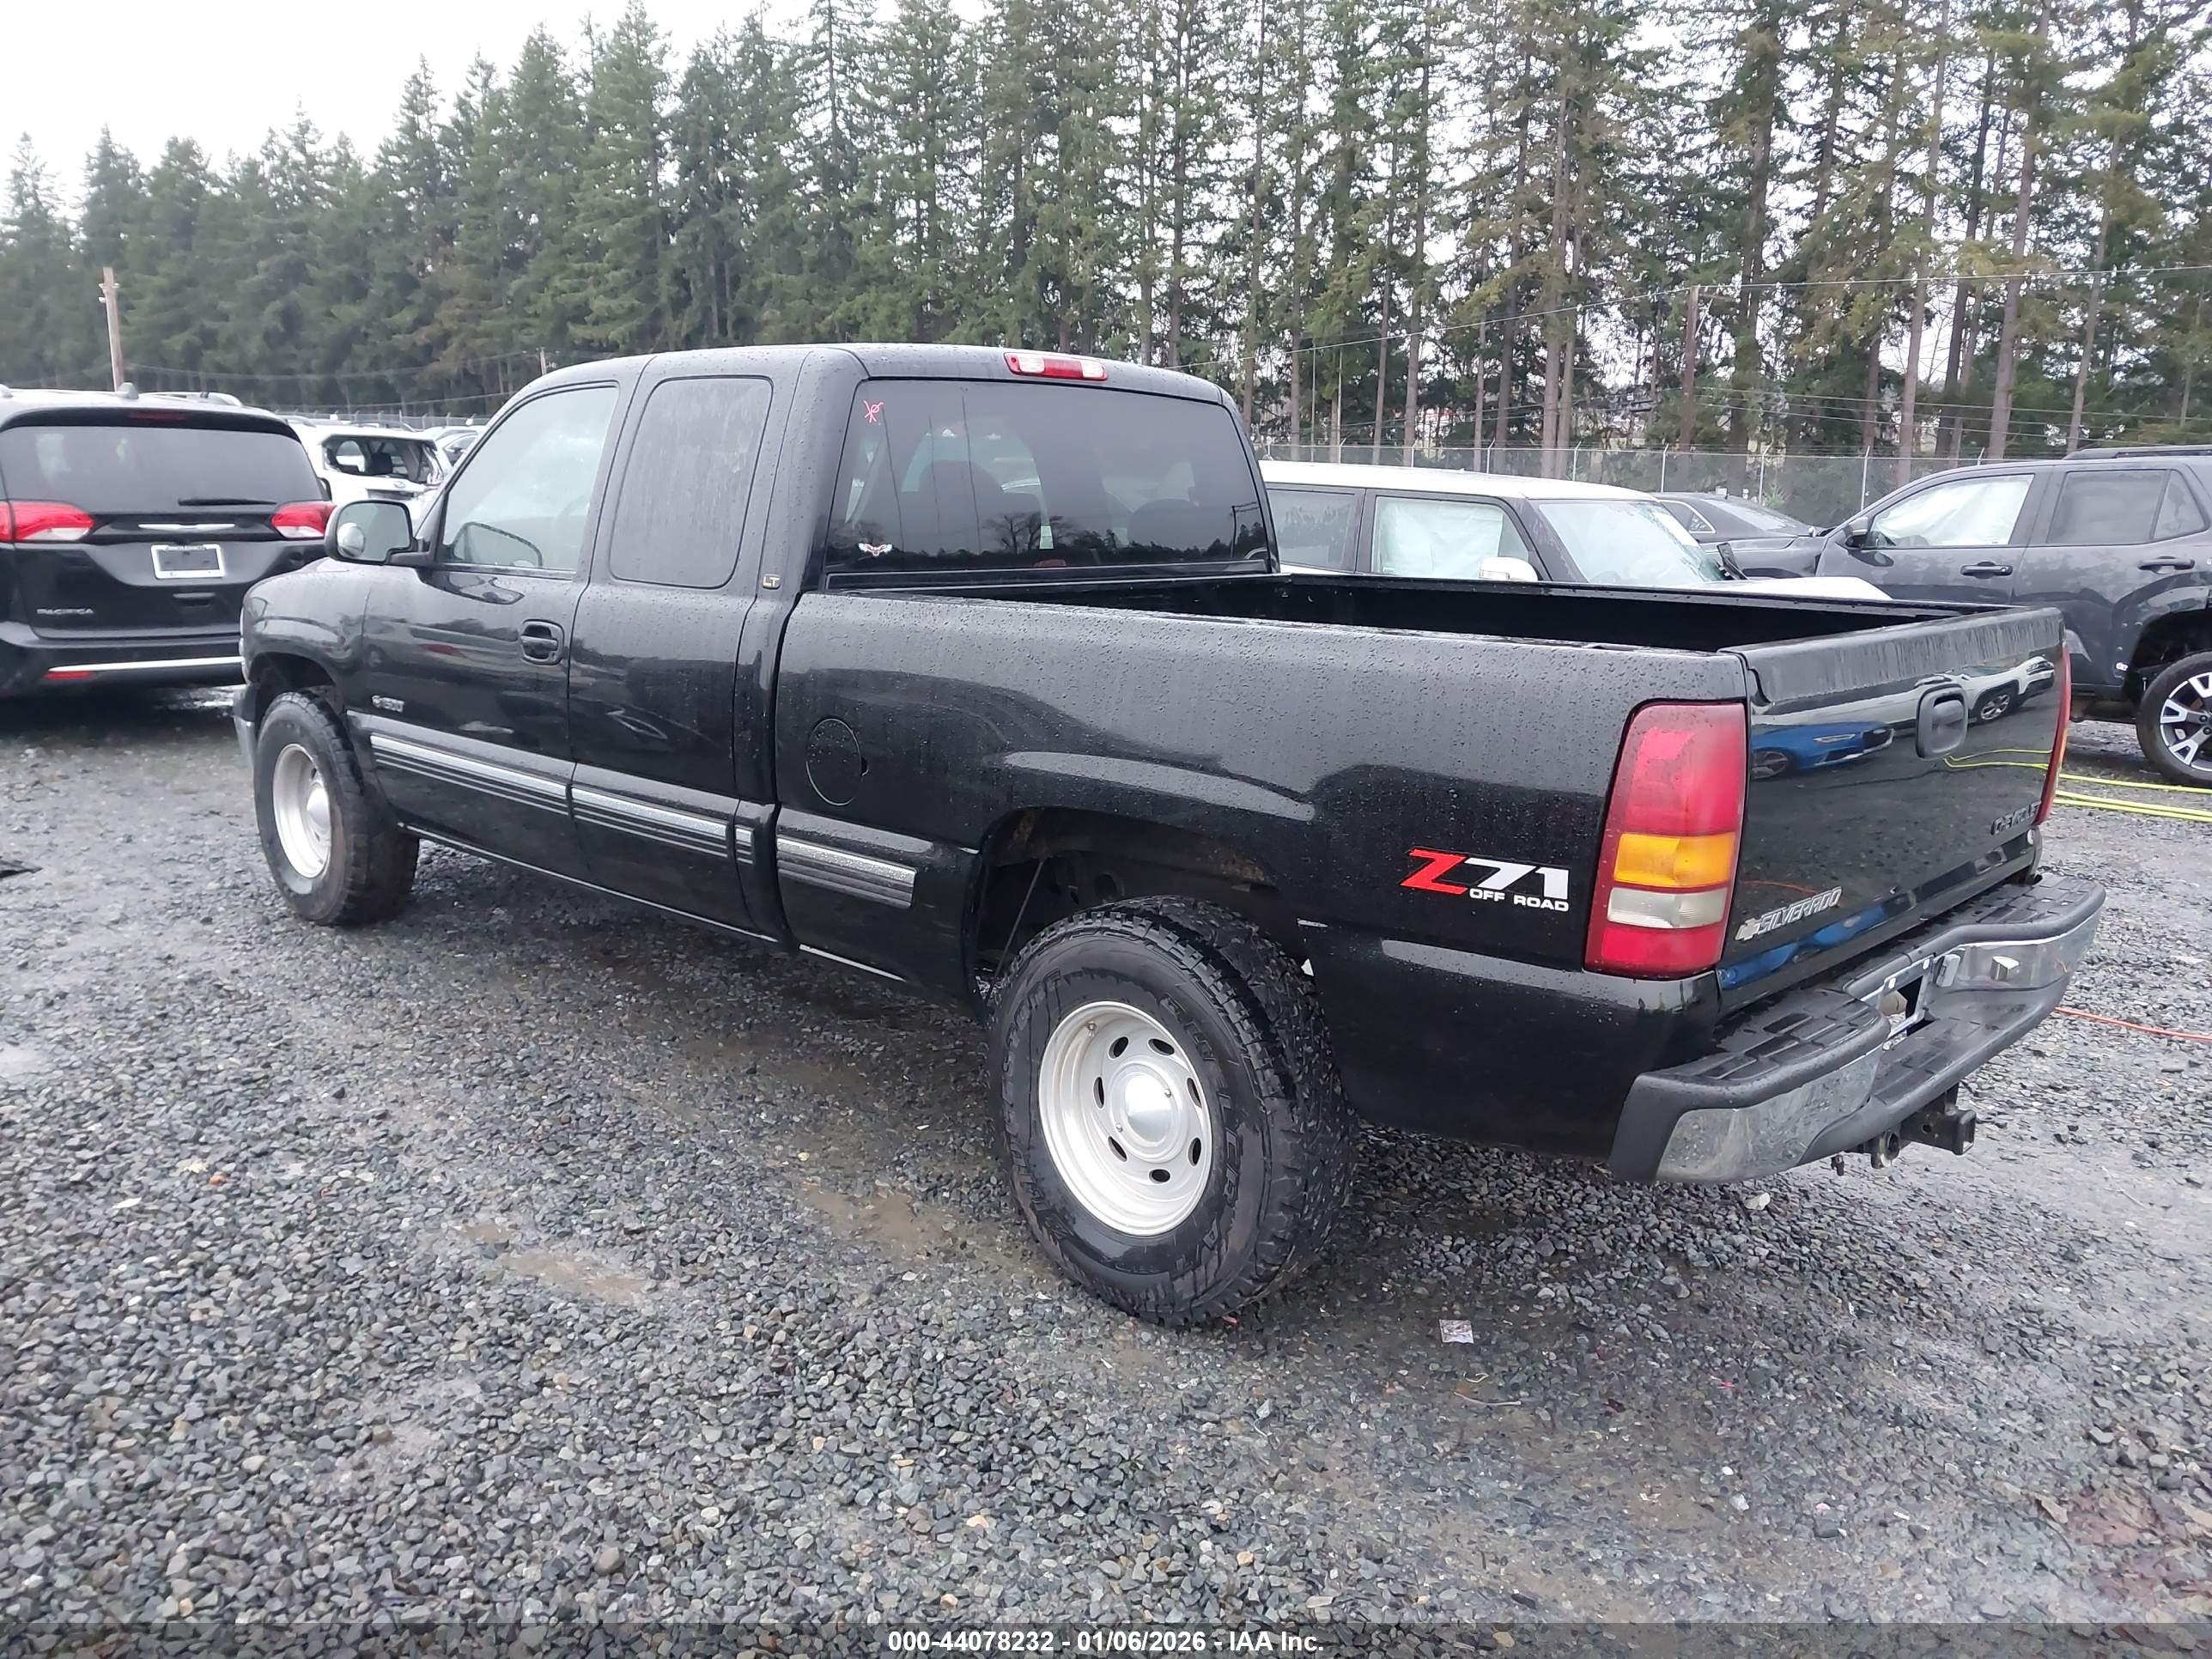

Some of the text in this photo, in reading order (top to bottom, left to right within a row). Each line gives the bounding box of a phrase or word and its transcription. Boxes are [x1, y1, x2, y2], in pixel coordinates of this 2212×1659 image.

[763, 576, 780, 586] LT
[1401, 848, 1569, 900] Z71
[1469, 888, 1569, 912] OFF ROAD
[1758, 886, 1842, 934] SILVERADO
